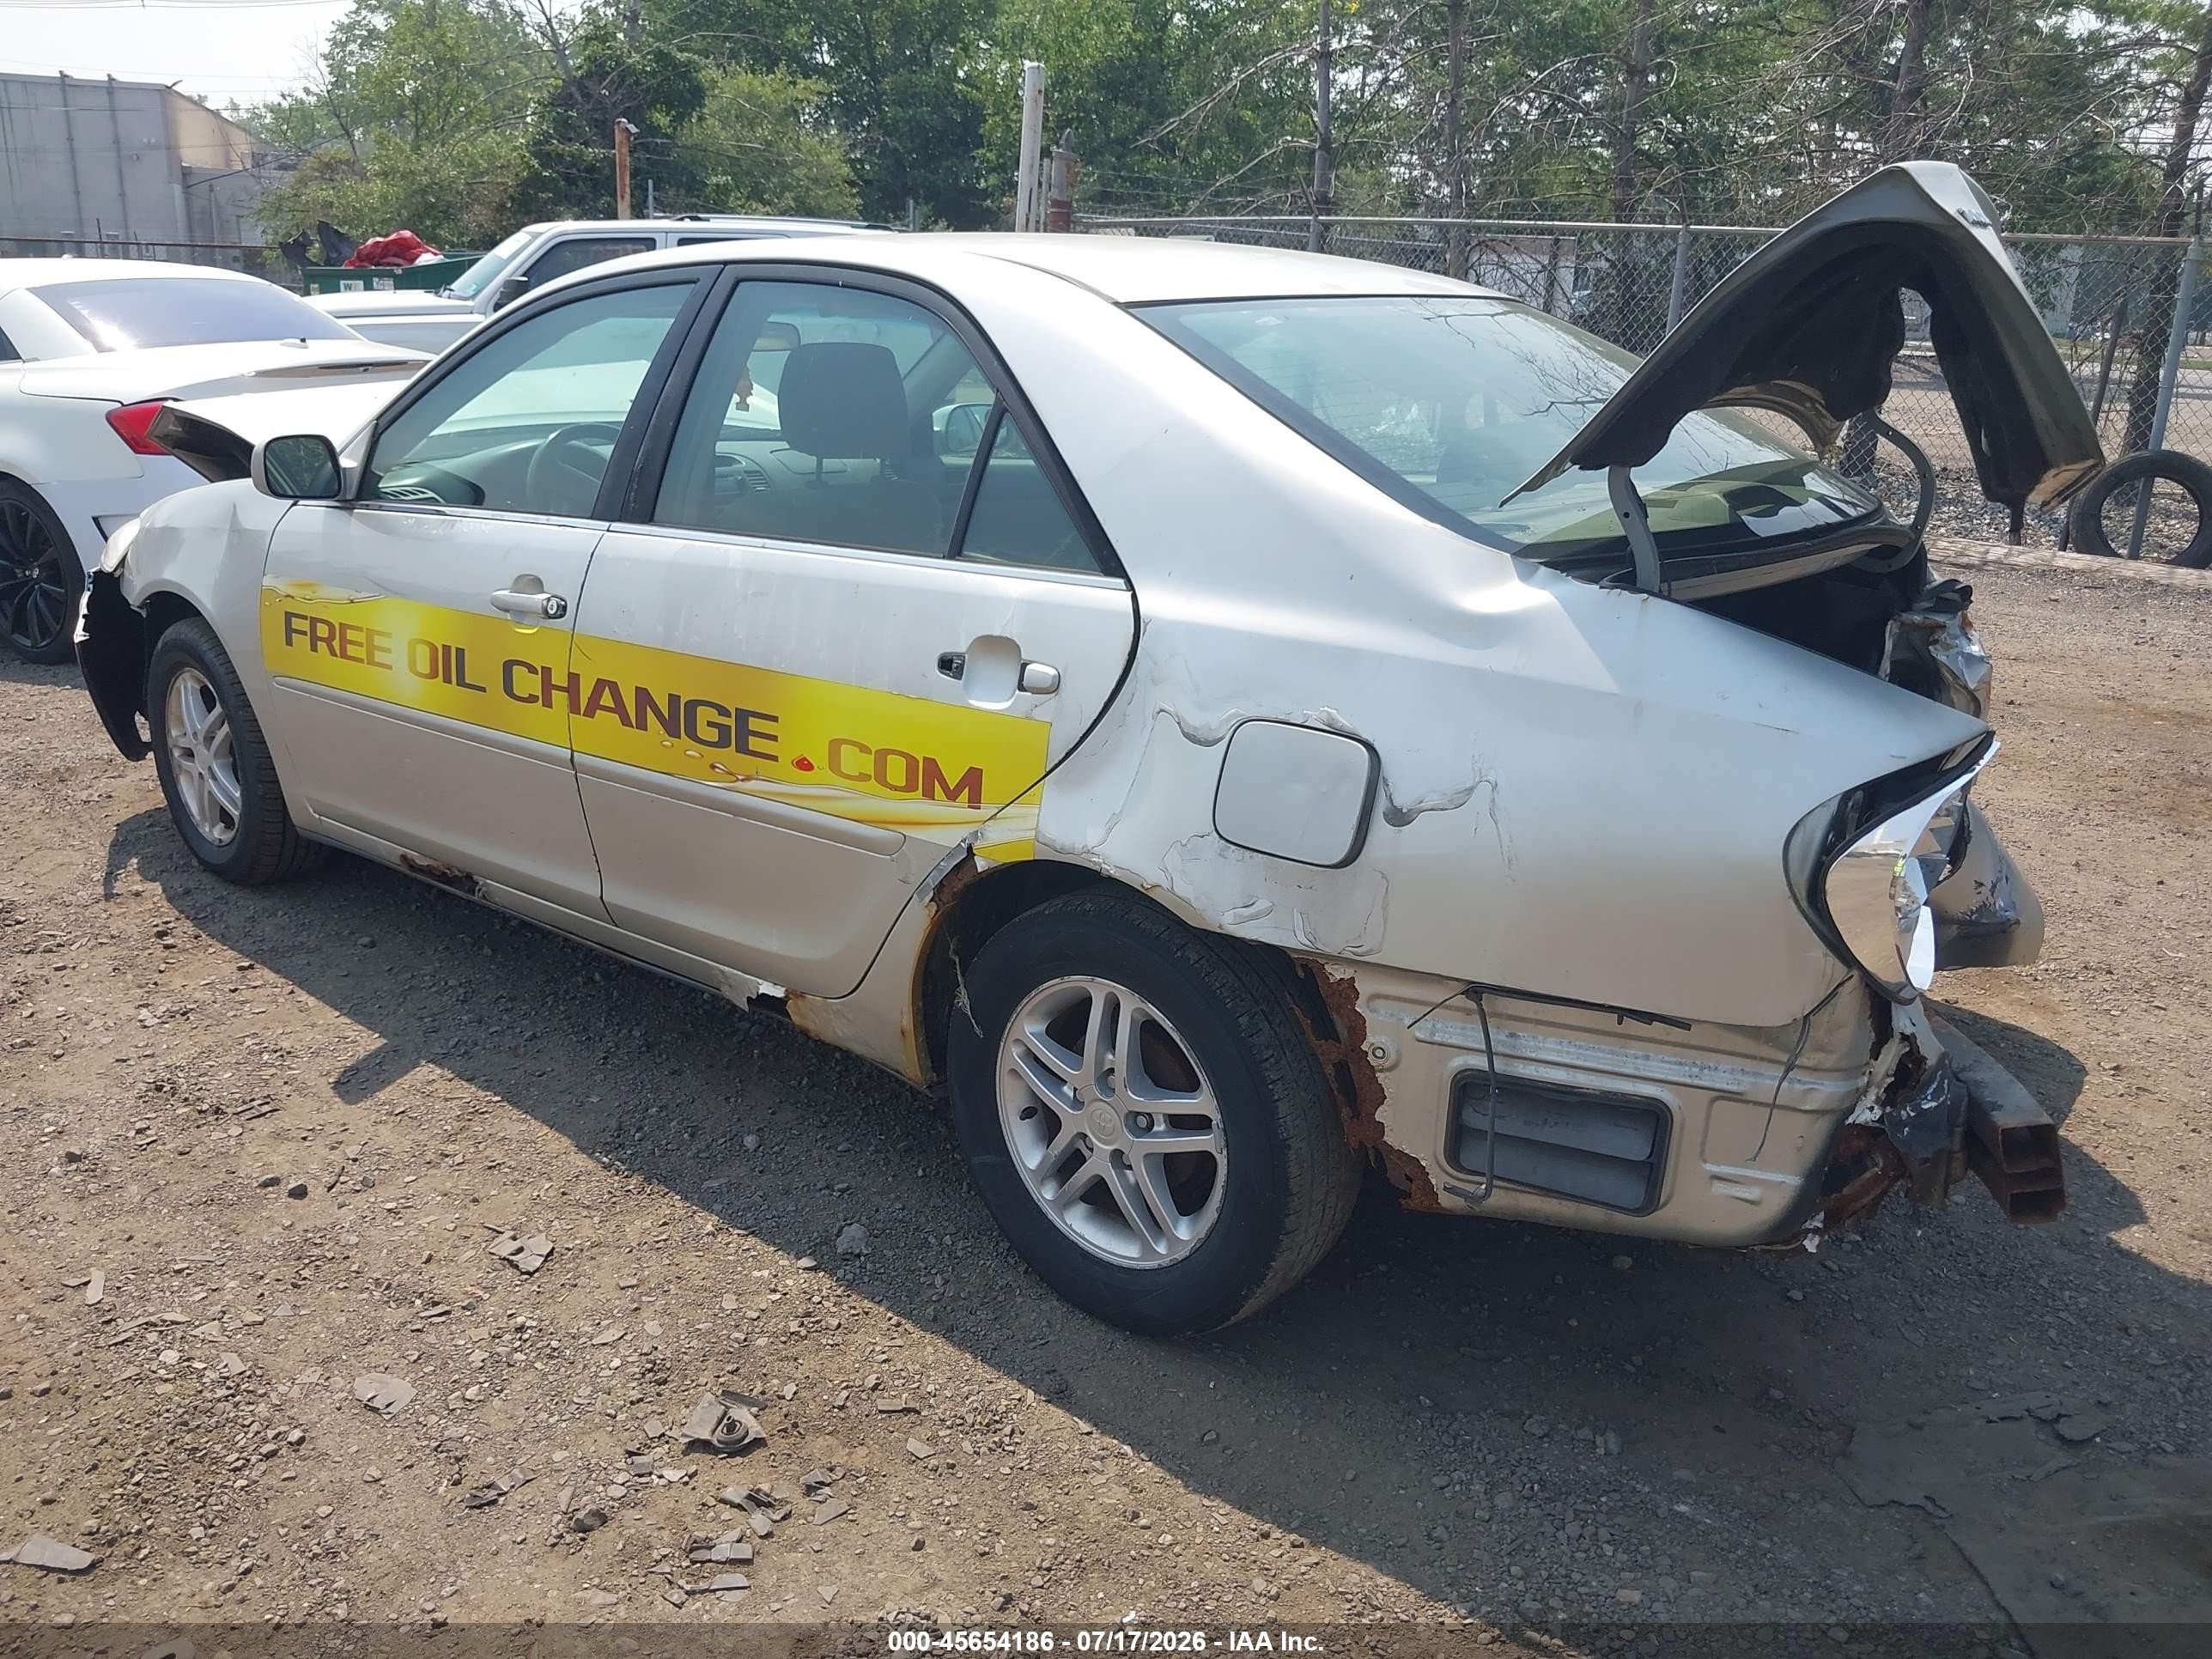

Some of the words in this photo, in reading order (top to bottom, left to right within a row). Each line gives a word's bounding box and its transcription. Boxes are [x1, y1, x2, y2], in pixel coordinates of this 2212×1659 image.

[284, 611, 392, 670] FREE
[407, 638, 487, 693] OIL
[502, 659, 779, 763] CHANGE
